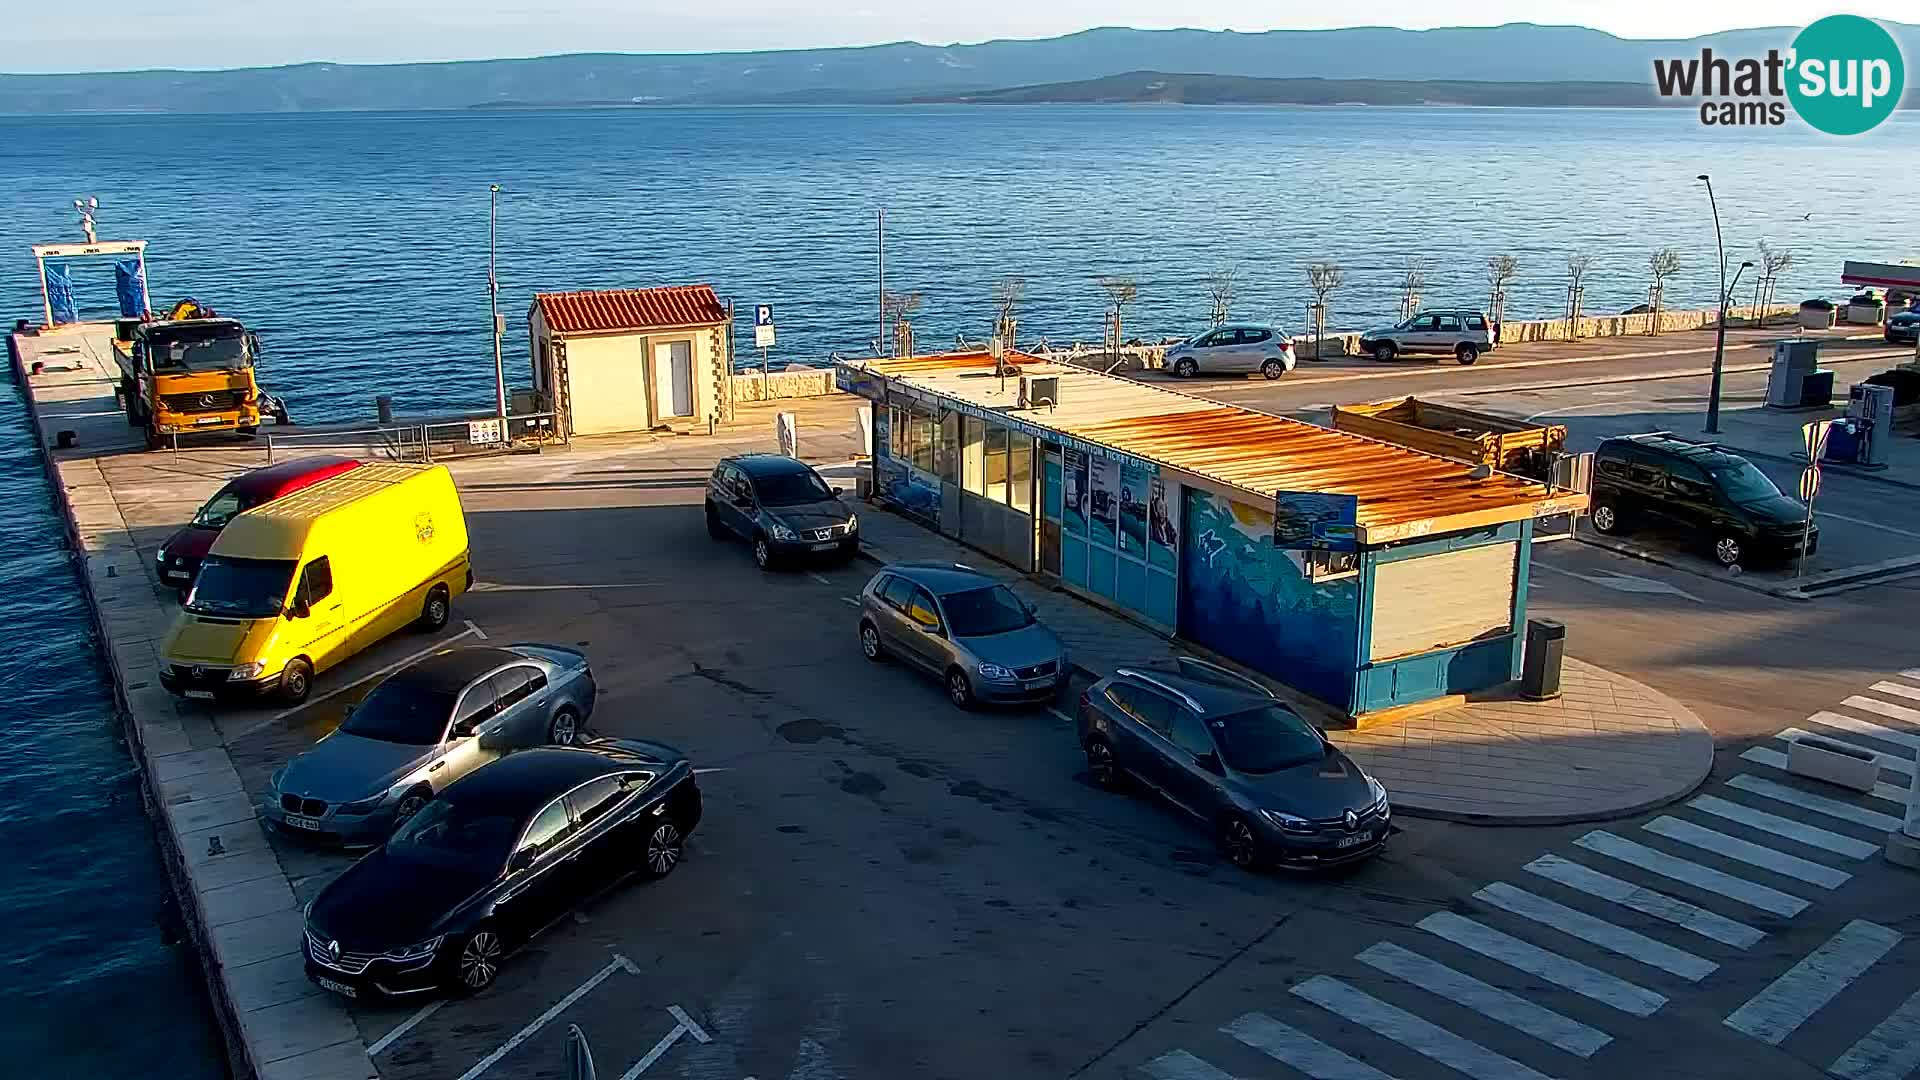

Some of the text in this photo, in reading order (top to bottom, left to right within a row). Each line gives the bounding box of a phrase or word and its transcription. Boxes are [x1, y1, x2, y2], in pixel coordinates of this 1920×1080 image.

[759, 306, 770, 325] P
[1059, 435, 1073, 447] BUS
[1073, 441, 1104, 457] STATION
[1105, 450, 1130, 465] TICKET
[1130, 457, 1156, 473] OFFICE
